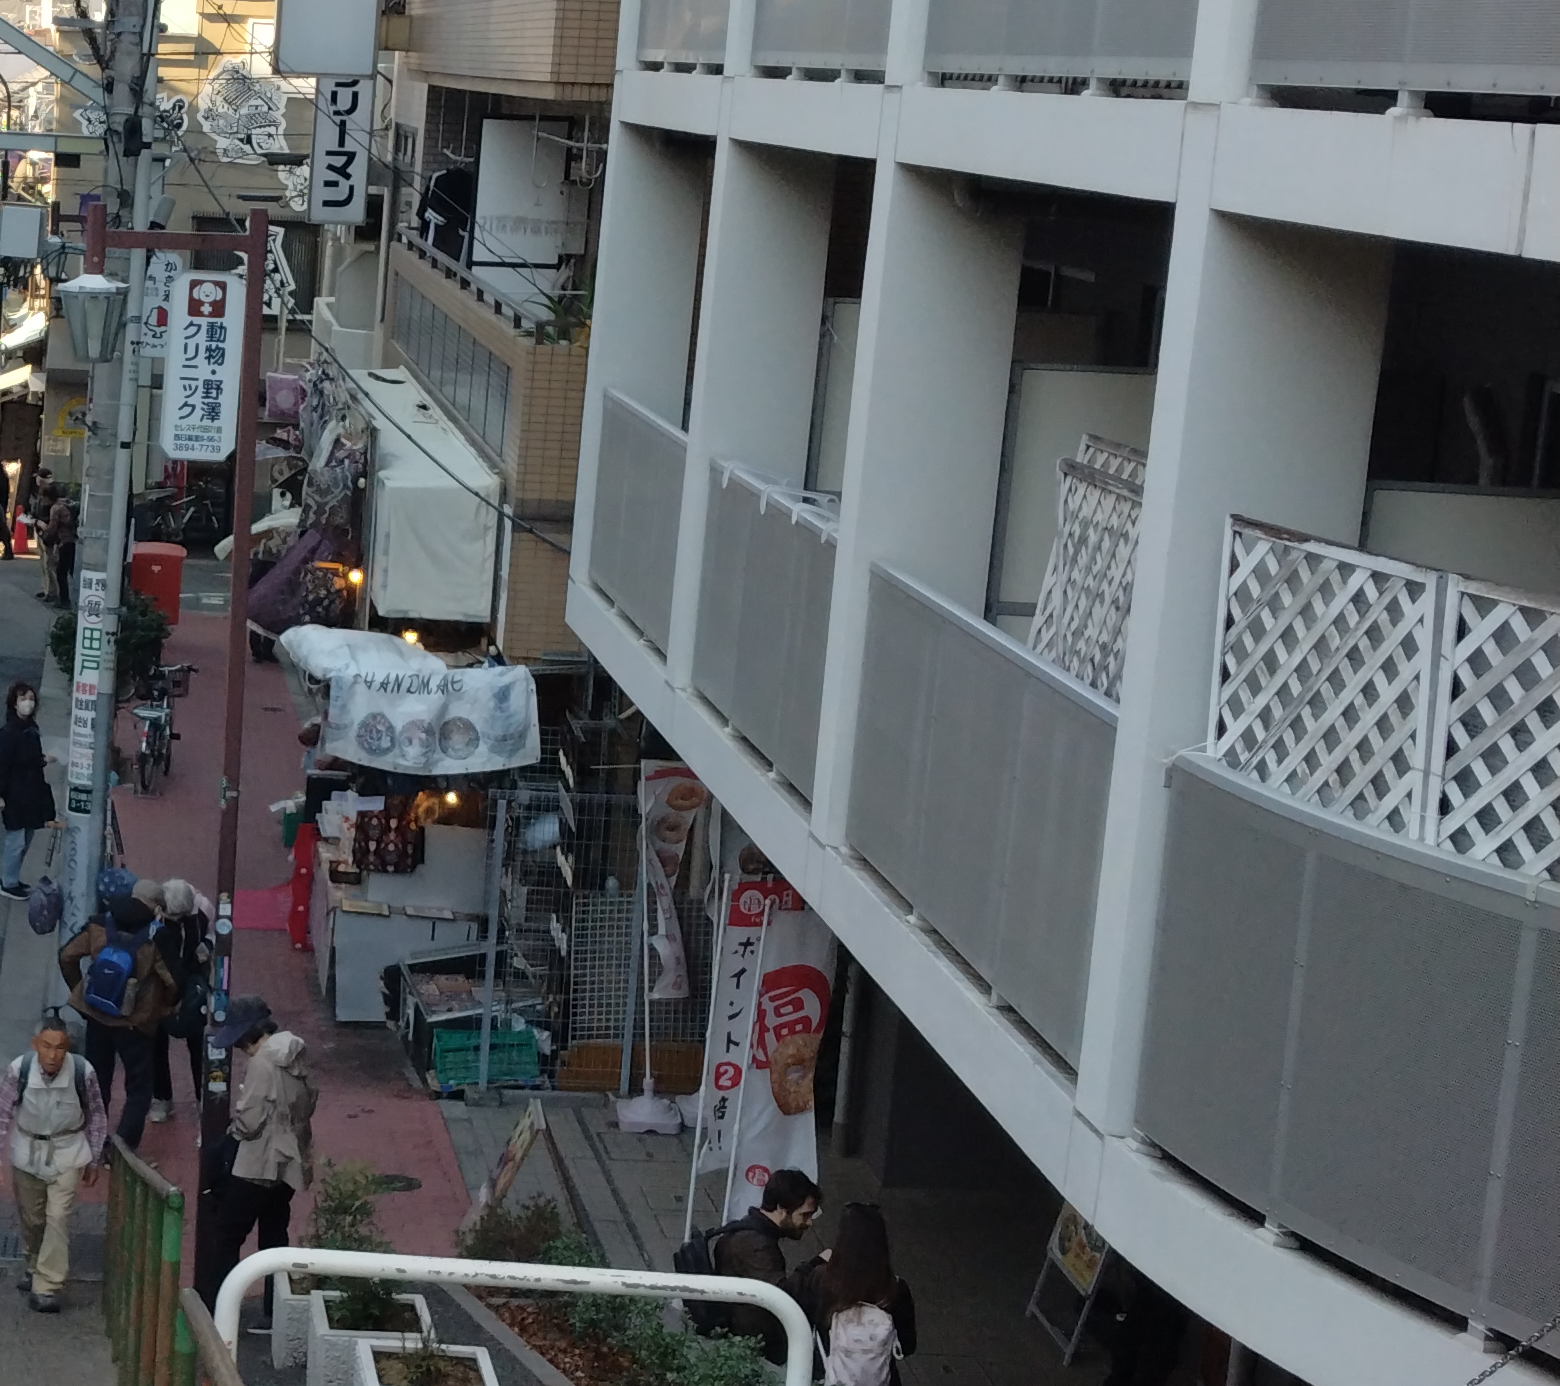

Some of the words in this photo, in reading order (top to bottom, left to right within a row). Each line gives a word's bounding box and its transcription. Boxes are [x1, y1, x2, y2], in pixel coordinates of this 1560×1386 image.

[178, 320, 203, 421] クリニック
[200, 321, 228, 423] 動物・野澤
